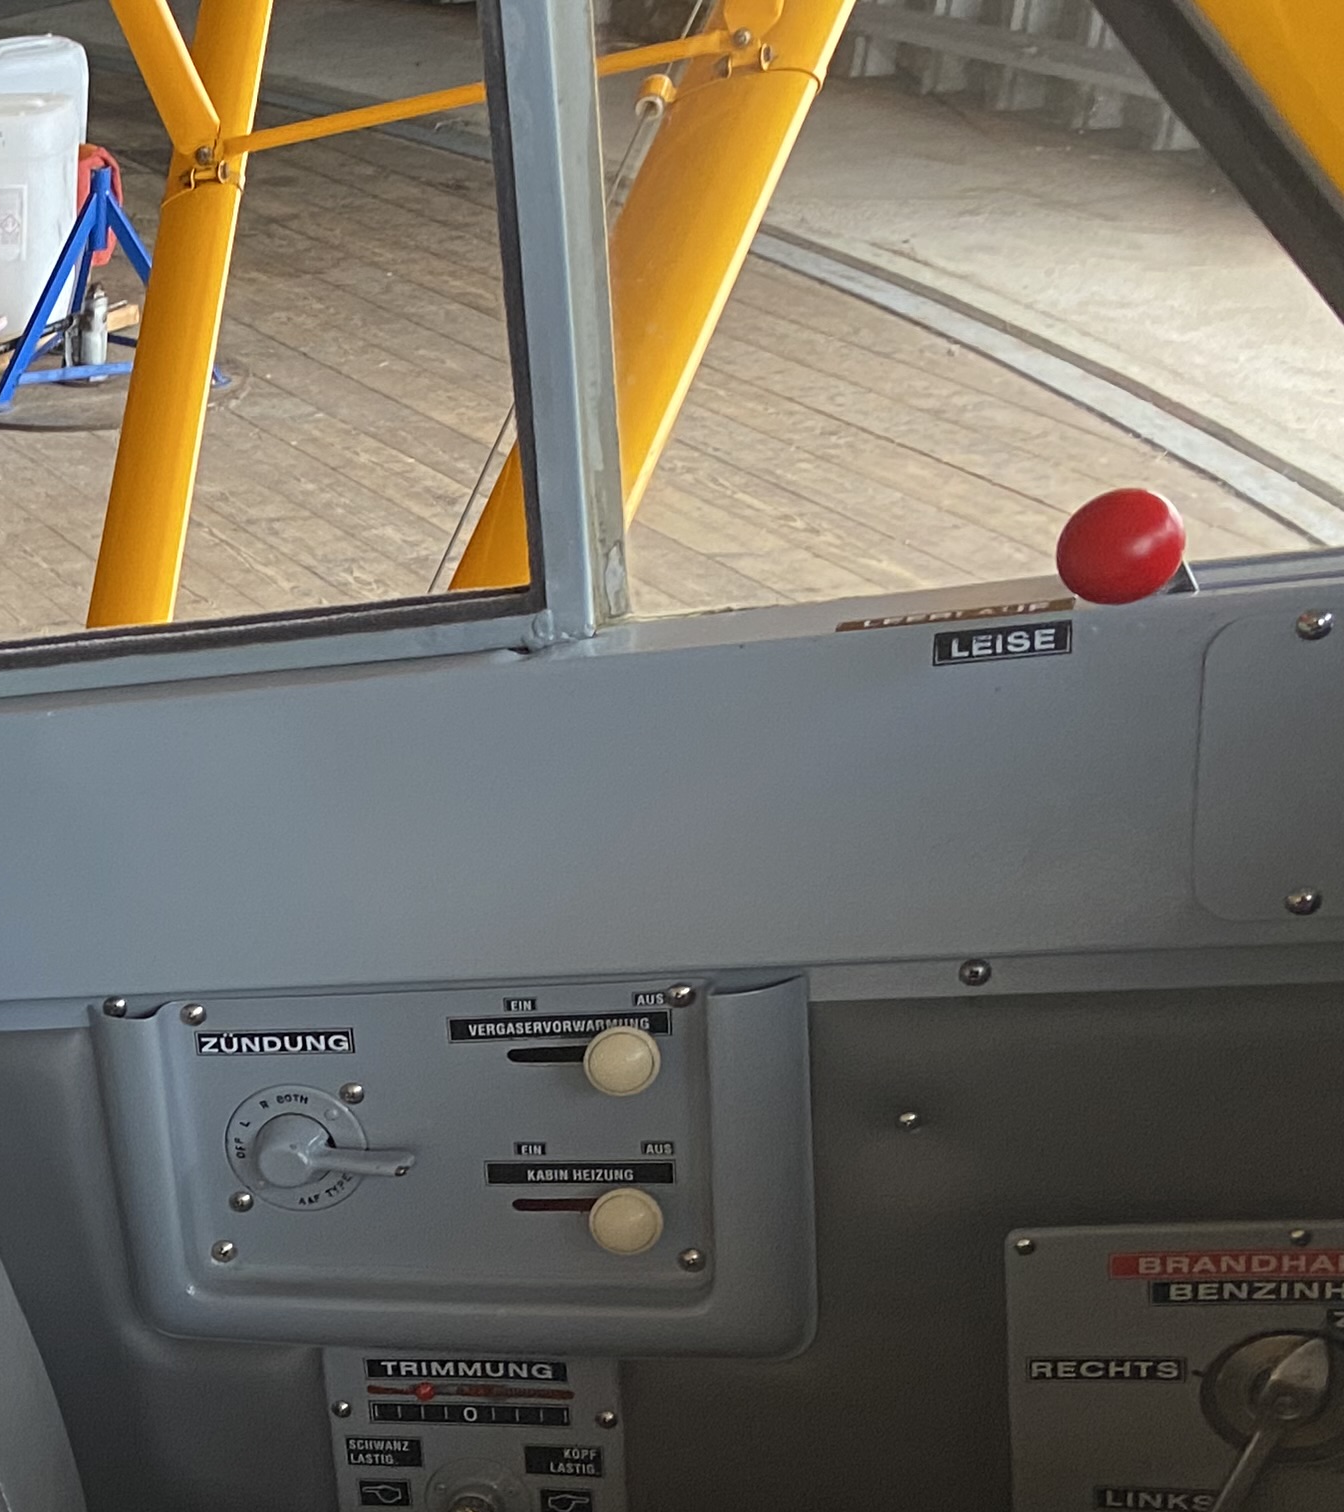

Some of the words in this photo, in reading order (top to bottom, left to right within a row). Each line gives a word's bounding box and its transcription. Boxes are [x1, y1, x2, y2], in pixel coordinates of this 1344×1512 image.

[951, 628, 1055, 658] LEISE
[511, 1001, 532, 1011] EIN
[637, 994, 664, 1005] AUS
[200, 1033, 349, 1053] ZÜNDUNG
[234, 1137, 246, 1159] OFF
[276, 1094, 309, 1104] BOTH
[521, 1145, 542, 1154] EIN
[646, 1144, 672, 1154] AUS
[527, 1169, 568, 1181] KABIN
[573, 1168, 634, 1181] HEIZUNG
[1138, 1254, 1344, 1275] BRANDHA
[381, 1361, 553, 1379] TRIMMUNG
[1030, 1361, 1179, 1379] RECHTS
[564, 1448, 597, 1460] KOPF
[1105, 1490, 1212, 1511] LINKS
